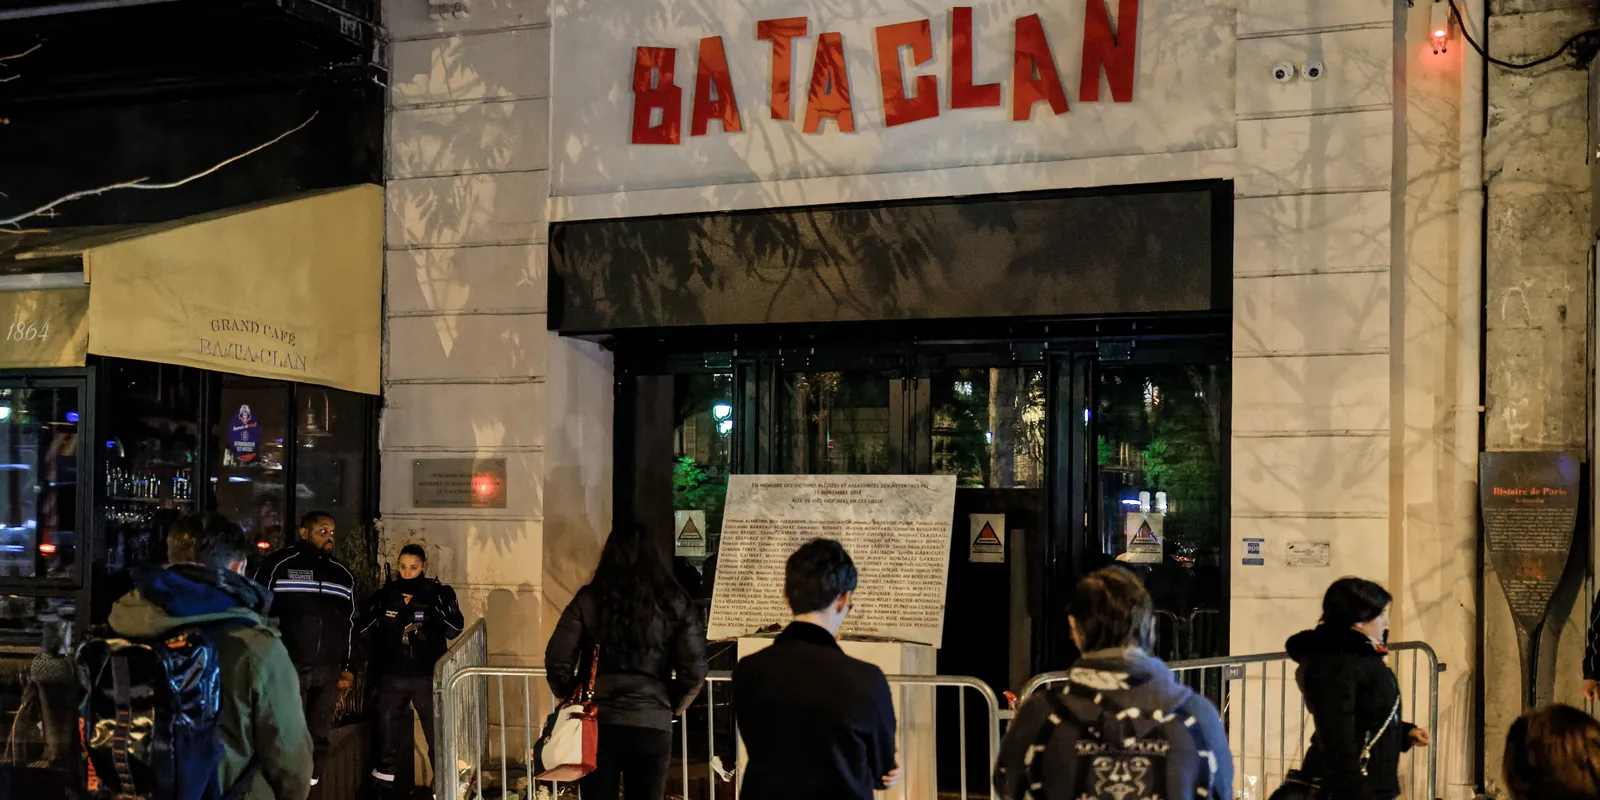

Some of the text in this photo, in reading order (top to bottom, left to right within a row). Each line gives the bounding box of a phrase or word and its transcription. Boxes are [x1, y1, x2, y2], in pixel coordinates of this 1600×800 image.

[631, 0, 1139, 145] BATACLAN
[6, 321, 50, 341] 1864
[210, 319, 260, 332] GRAND
[1492, 487, 1567, 496] Histoire de Paris
